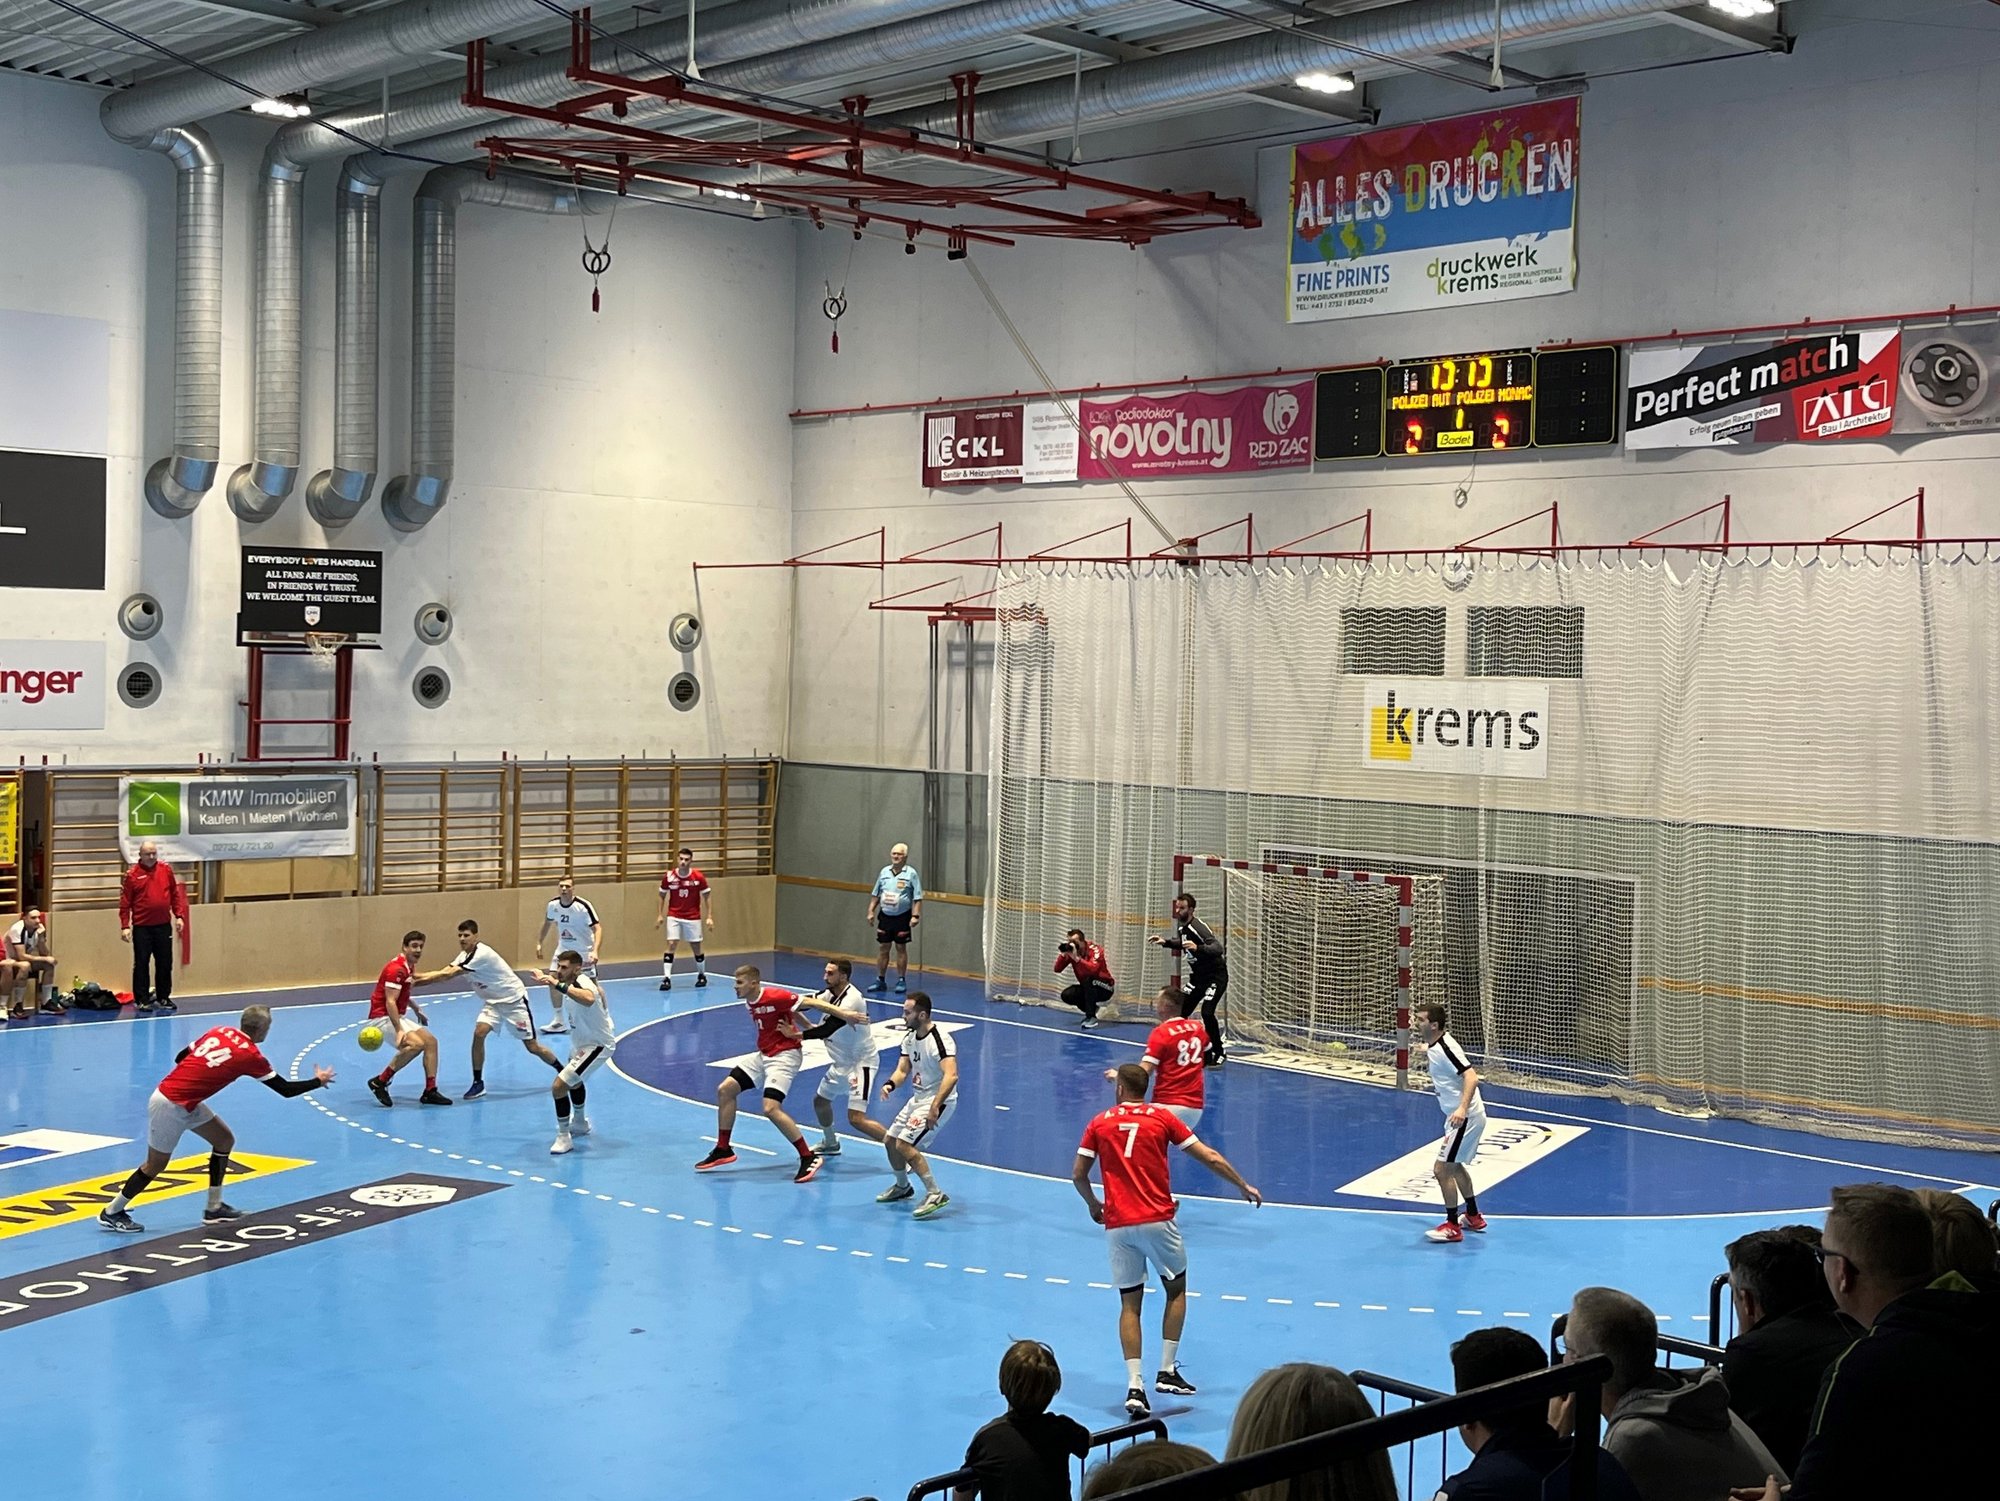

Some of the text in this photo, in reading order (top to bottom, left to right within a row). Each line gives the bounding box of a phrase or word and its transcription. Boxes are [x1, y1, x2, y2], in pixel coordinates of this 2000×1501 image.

[1296, 138, 1572, 230] ALLES DRUCKEN
[1427, 245, 1538, 279] druckwerk
[1297, 264, 1390, 292] FINE PRINTS
[1438, 273, 1499, 295] krems
[1634, 337, 1849, 422] Perfect match
[1392, 393, 1429, 410] POLIZEI
[1456, 389, 1495, 405] POLIZEI
[1808, 373, 1881, 427] ATC
[1689, 424, 1711, 436] Erfolg
[1732, 412, 1753, 423] Raum
[1754, 407, 1778, 419] geben
[1821, 409, 1890, 435] Bau Architektur
[941, 435, 1004, 460] ECKL
[1089, 412, 1233, 468] novotny
[1249, 436, 1309, 459] RED ZAC
[247, 555, 301, 564] EVERYBODY
[330, 558, 377, 568] HANDBALL
[265, 570, 282, 579] ALL
[282, 570, 304, 580] FANS
[305, 572, 322, 580] ARE
[246, 592, 261, 600] WE
[262, 592, 305, 602] WELCOME
[305, 593, 322, 602] THE
[323, 594, 349, 603] GUEST
[267, 581, 277, 589] IN
[278, 582, 313, 591] FRIENDS
[314, 583, 328, 591] WE
[0, 663, 83, 704] nger
[1385, 689, 1541, 751] krems
[199, 788, 337, 807] KMW Immobilien
[199, 810, 338, 826] Kaufen Mieten Wohnen
[193, 1036, 232, 1069] 84
[1177, 1036, 1203, 1067] 82
[1118, 1123, 1140, 1159] 7
[316, 1205, 365, 1219] DER
